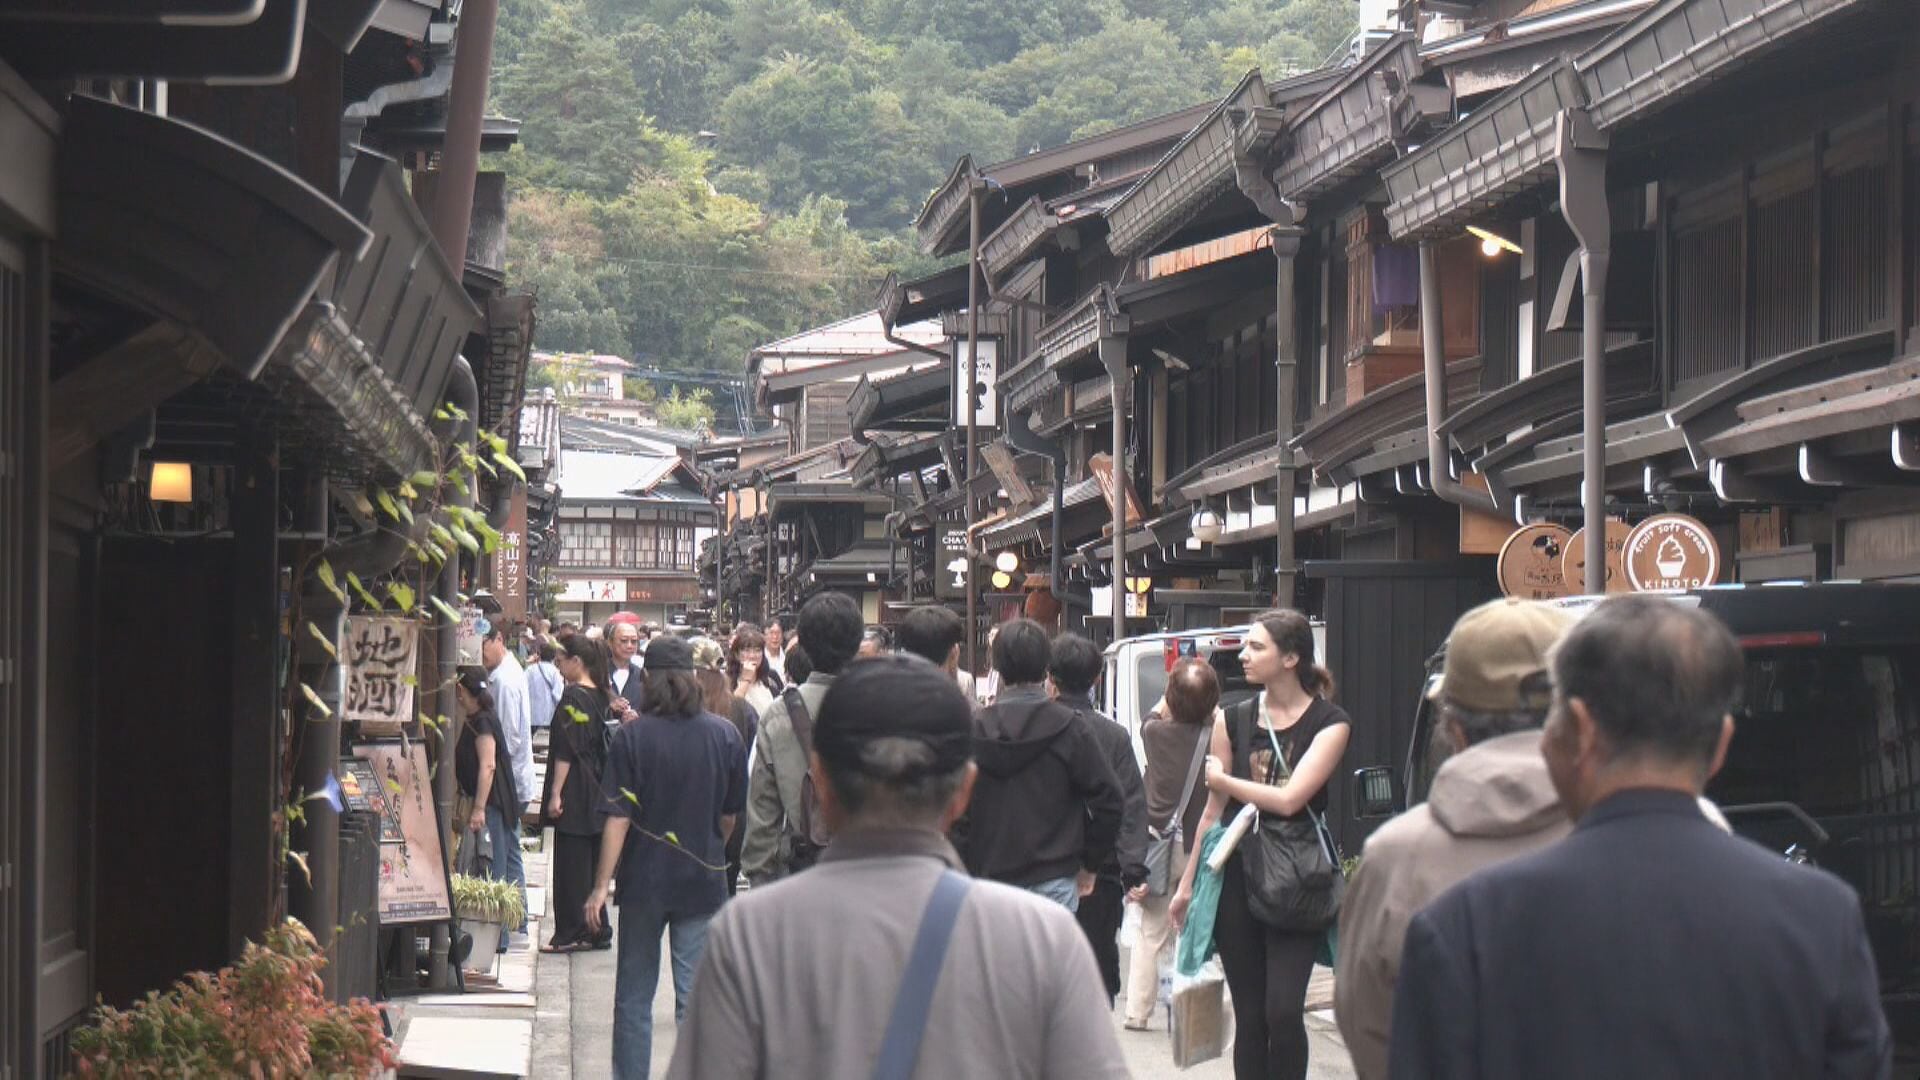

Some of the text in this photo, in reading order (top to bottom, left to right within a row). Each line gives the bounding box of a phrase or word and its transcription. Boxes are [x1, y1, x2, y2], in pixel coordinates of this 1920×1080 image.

[505, 530, 521, 597] 高山カフェ
[1658, 523, 1681, 534] soft
[1684, 528, 1706, 555] cream
[1644, 580, 1701, 590] KINOTO
[348, 625, 410, 716] 地酒
